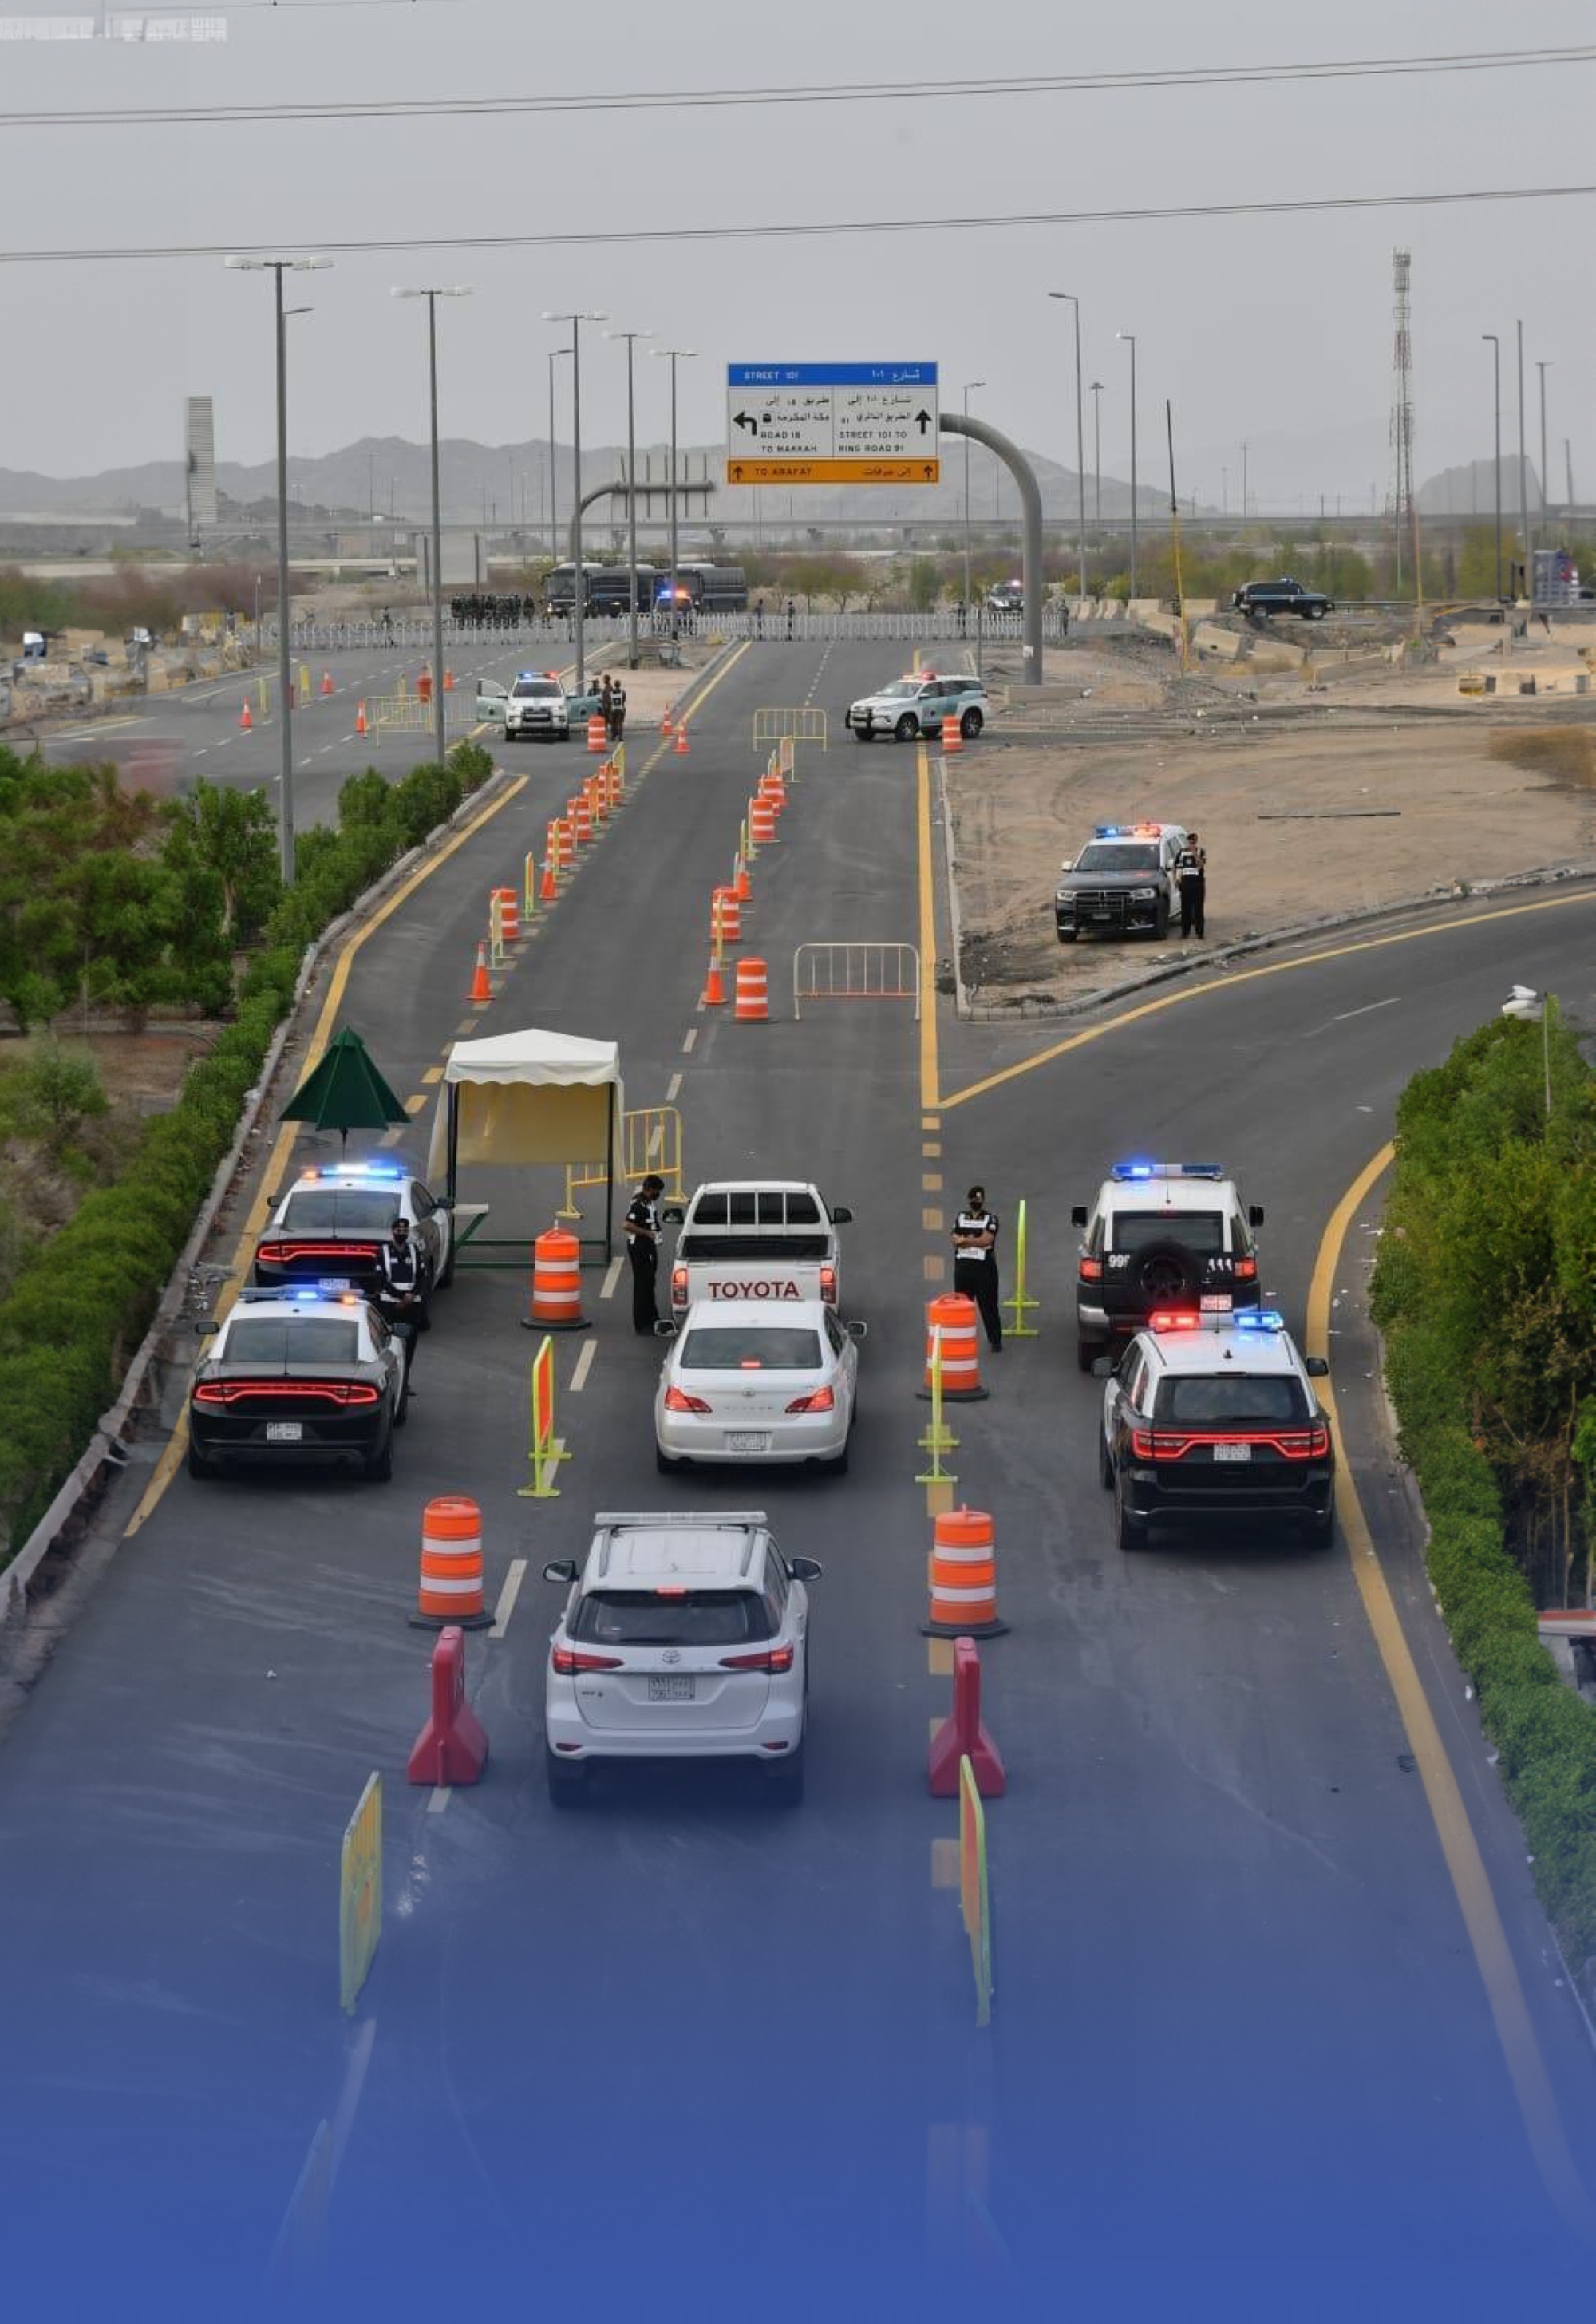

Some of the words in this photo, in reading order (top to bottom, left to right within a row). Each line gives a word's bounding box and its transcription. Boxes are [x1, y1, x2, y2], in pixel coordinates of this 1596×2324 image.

[745, 371, 780, 380] STREET
[786, 371, 798, 380] 101
[893, 369, 920, 382] شارع
[804, 396, 829, 407] طريق
[883, 394, 911, 407] شارع
[777, 412, 810, 422] المكرمة
[813, 412, 829, 421] مكة
[755, 468, 767, 476] TO
[772, 468, 812, 477] ARAFAT
[707, 1280, 800, 1298] TOYOTA
